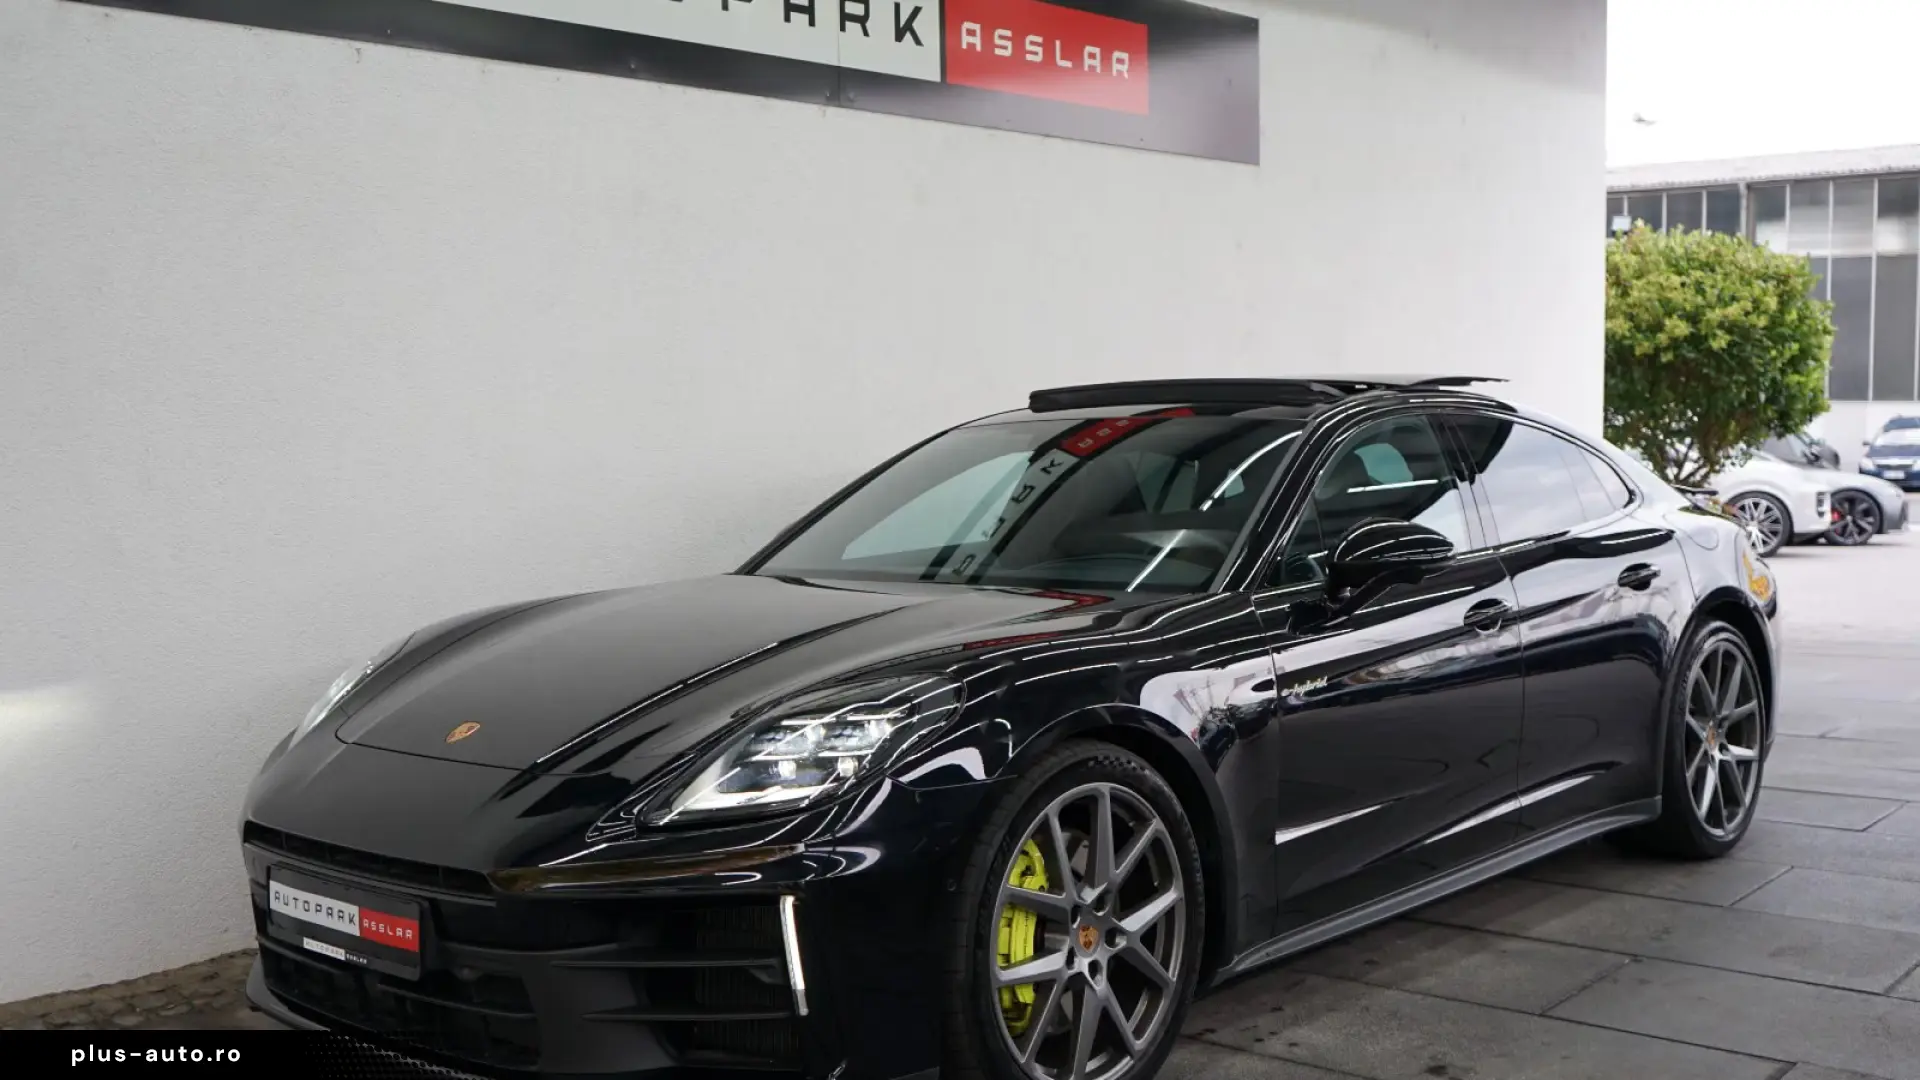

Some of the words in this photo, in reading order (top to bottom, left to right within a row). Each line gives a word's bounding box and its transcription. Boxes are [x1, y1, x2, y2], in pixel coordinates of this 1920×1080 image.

[668, 0, 924, 47] ARK
[960, 21, 1130, 79] ASSLAR
[274, 890, 357, 926] AUTOPARK
[363, 918, 413, 940] ASSLAR
